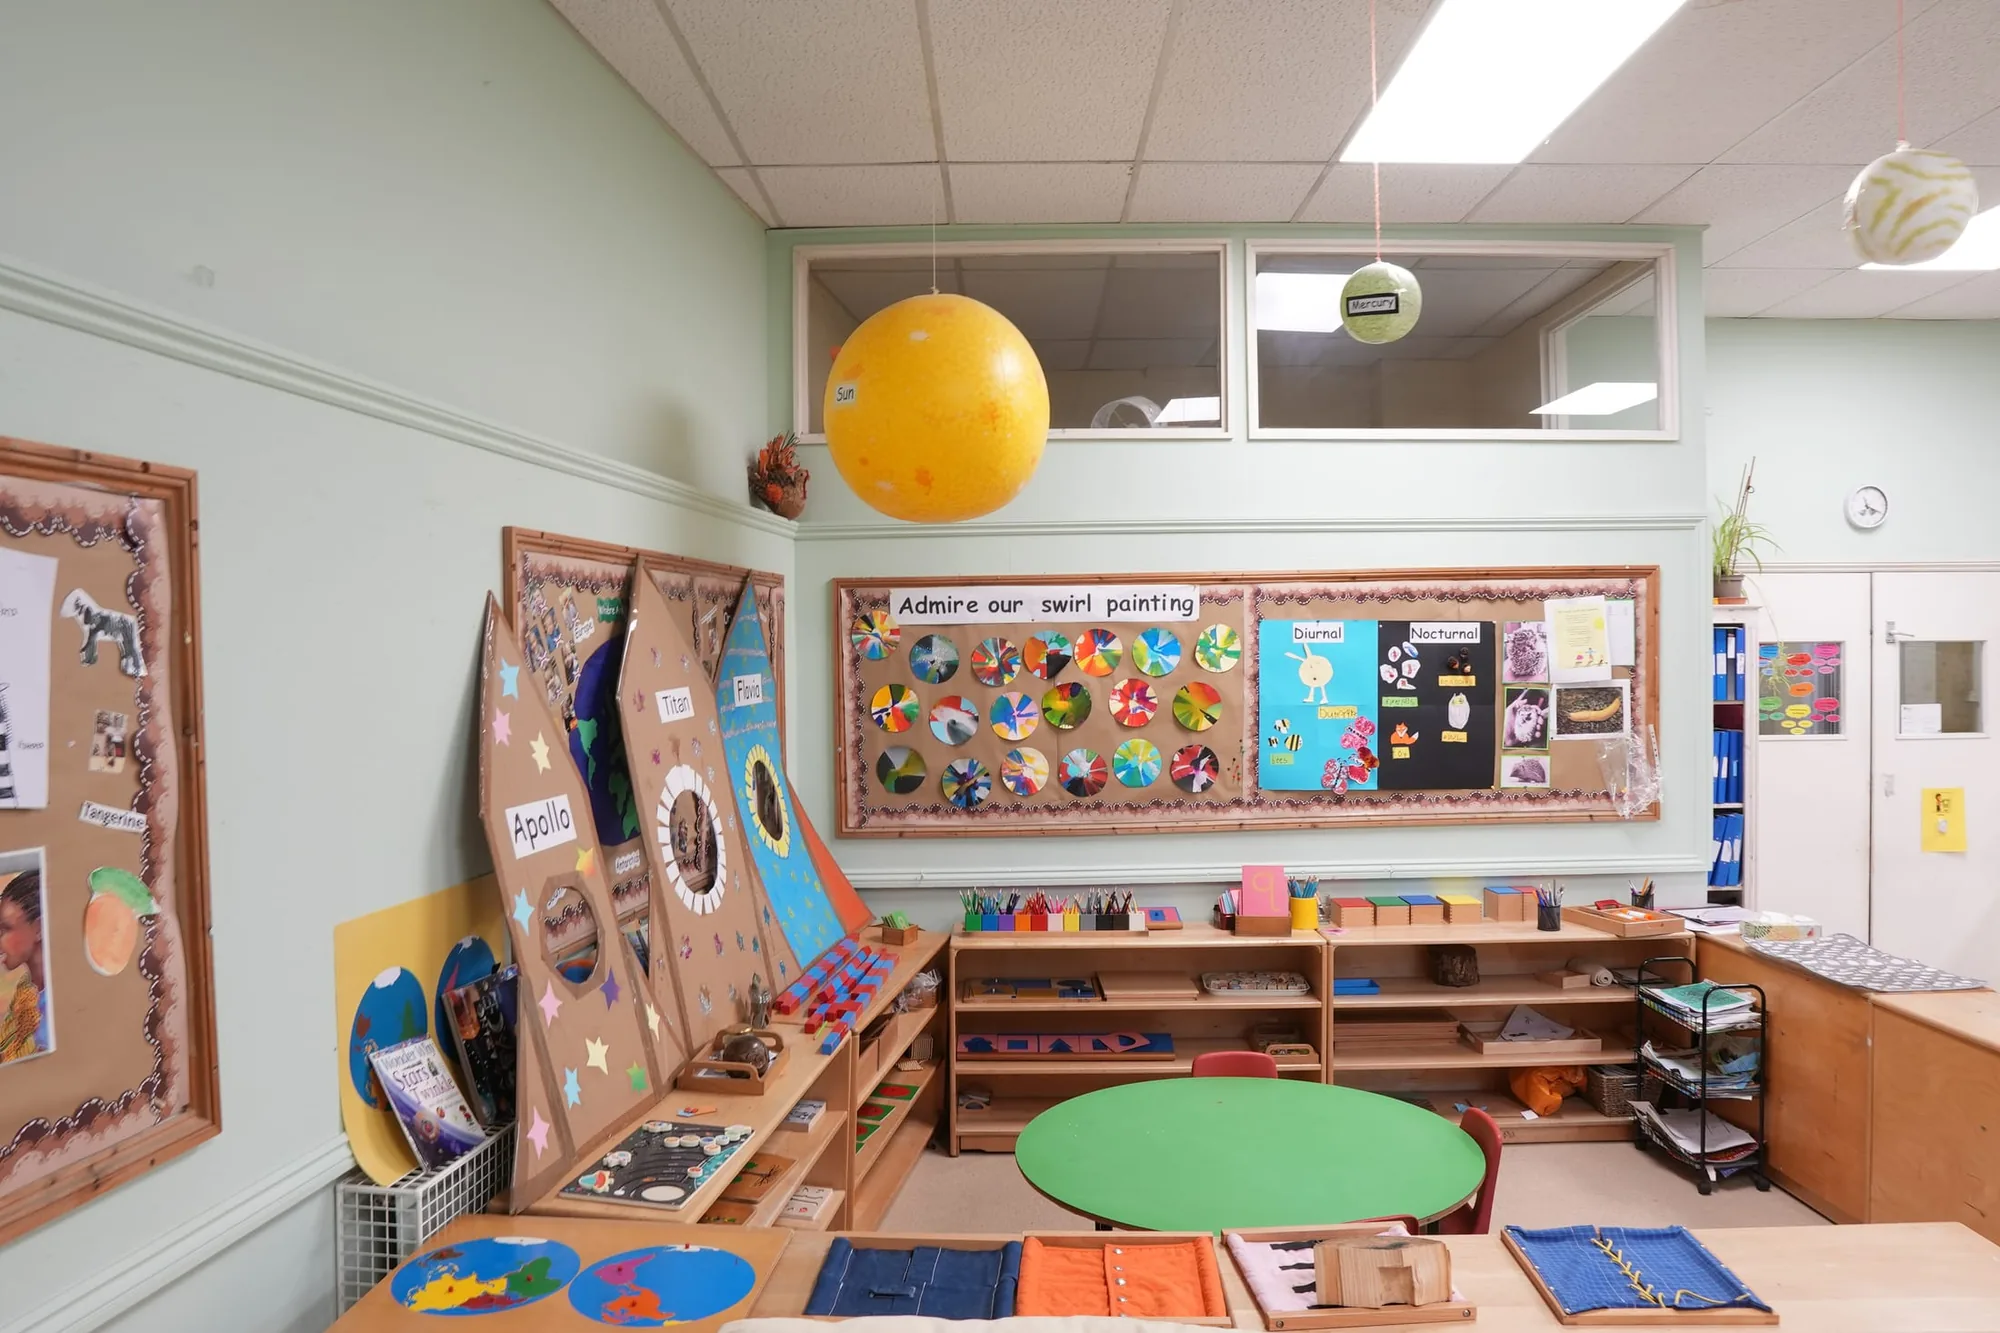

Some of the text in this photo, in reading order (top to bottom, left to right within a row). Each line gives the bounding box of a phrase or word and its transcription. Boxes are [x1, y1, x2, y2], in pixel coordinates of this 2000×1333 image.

[1351, 298, 1394, 310] Mercury
[837, 386, 854, 402] Sun
[899, 593, 1194, 617] Admire our swirl painting
[1294, 627, 1342, 640] Diurnal
[1411, 626, 1478, 640] Nocturnal
[737, 680, 760, 702] Flavia
[662, 695, 691, 716] Titan
[84, 802, 145, 829] Tangerine
[515, 800, 570, 850] Apollo
[393, 1066, 430, 1091] Stars
[410, 1074, 456, 1104] Twinkle
